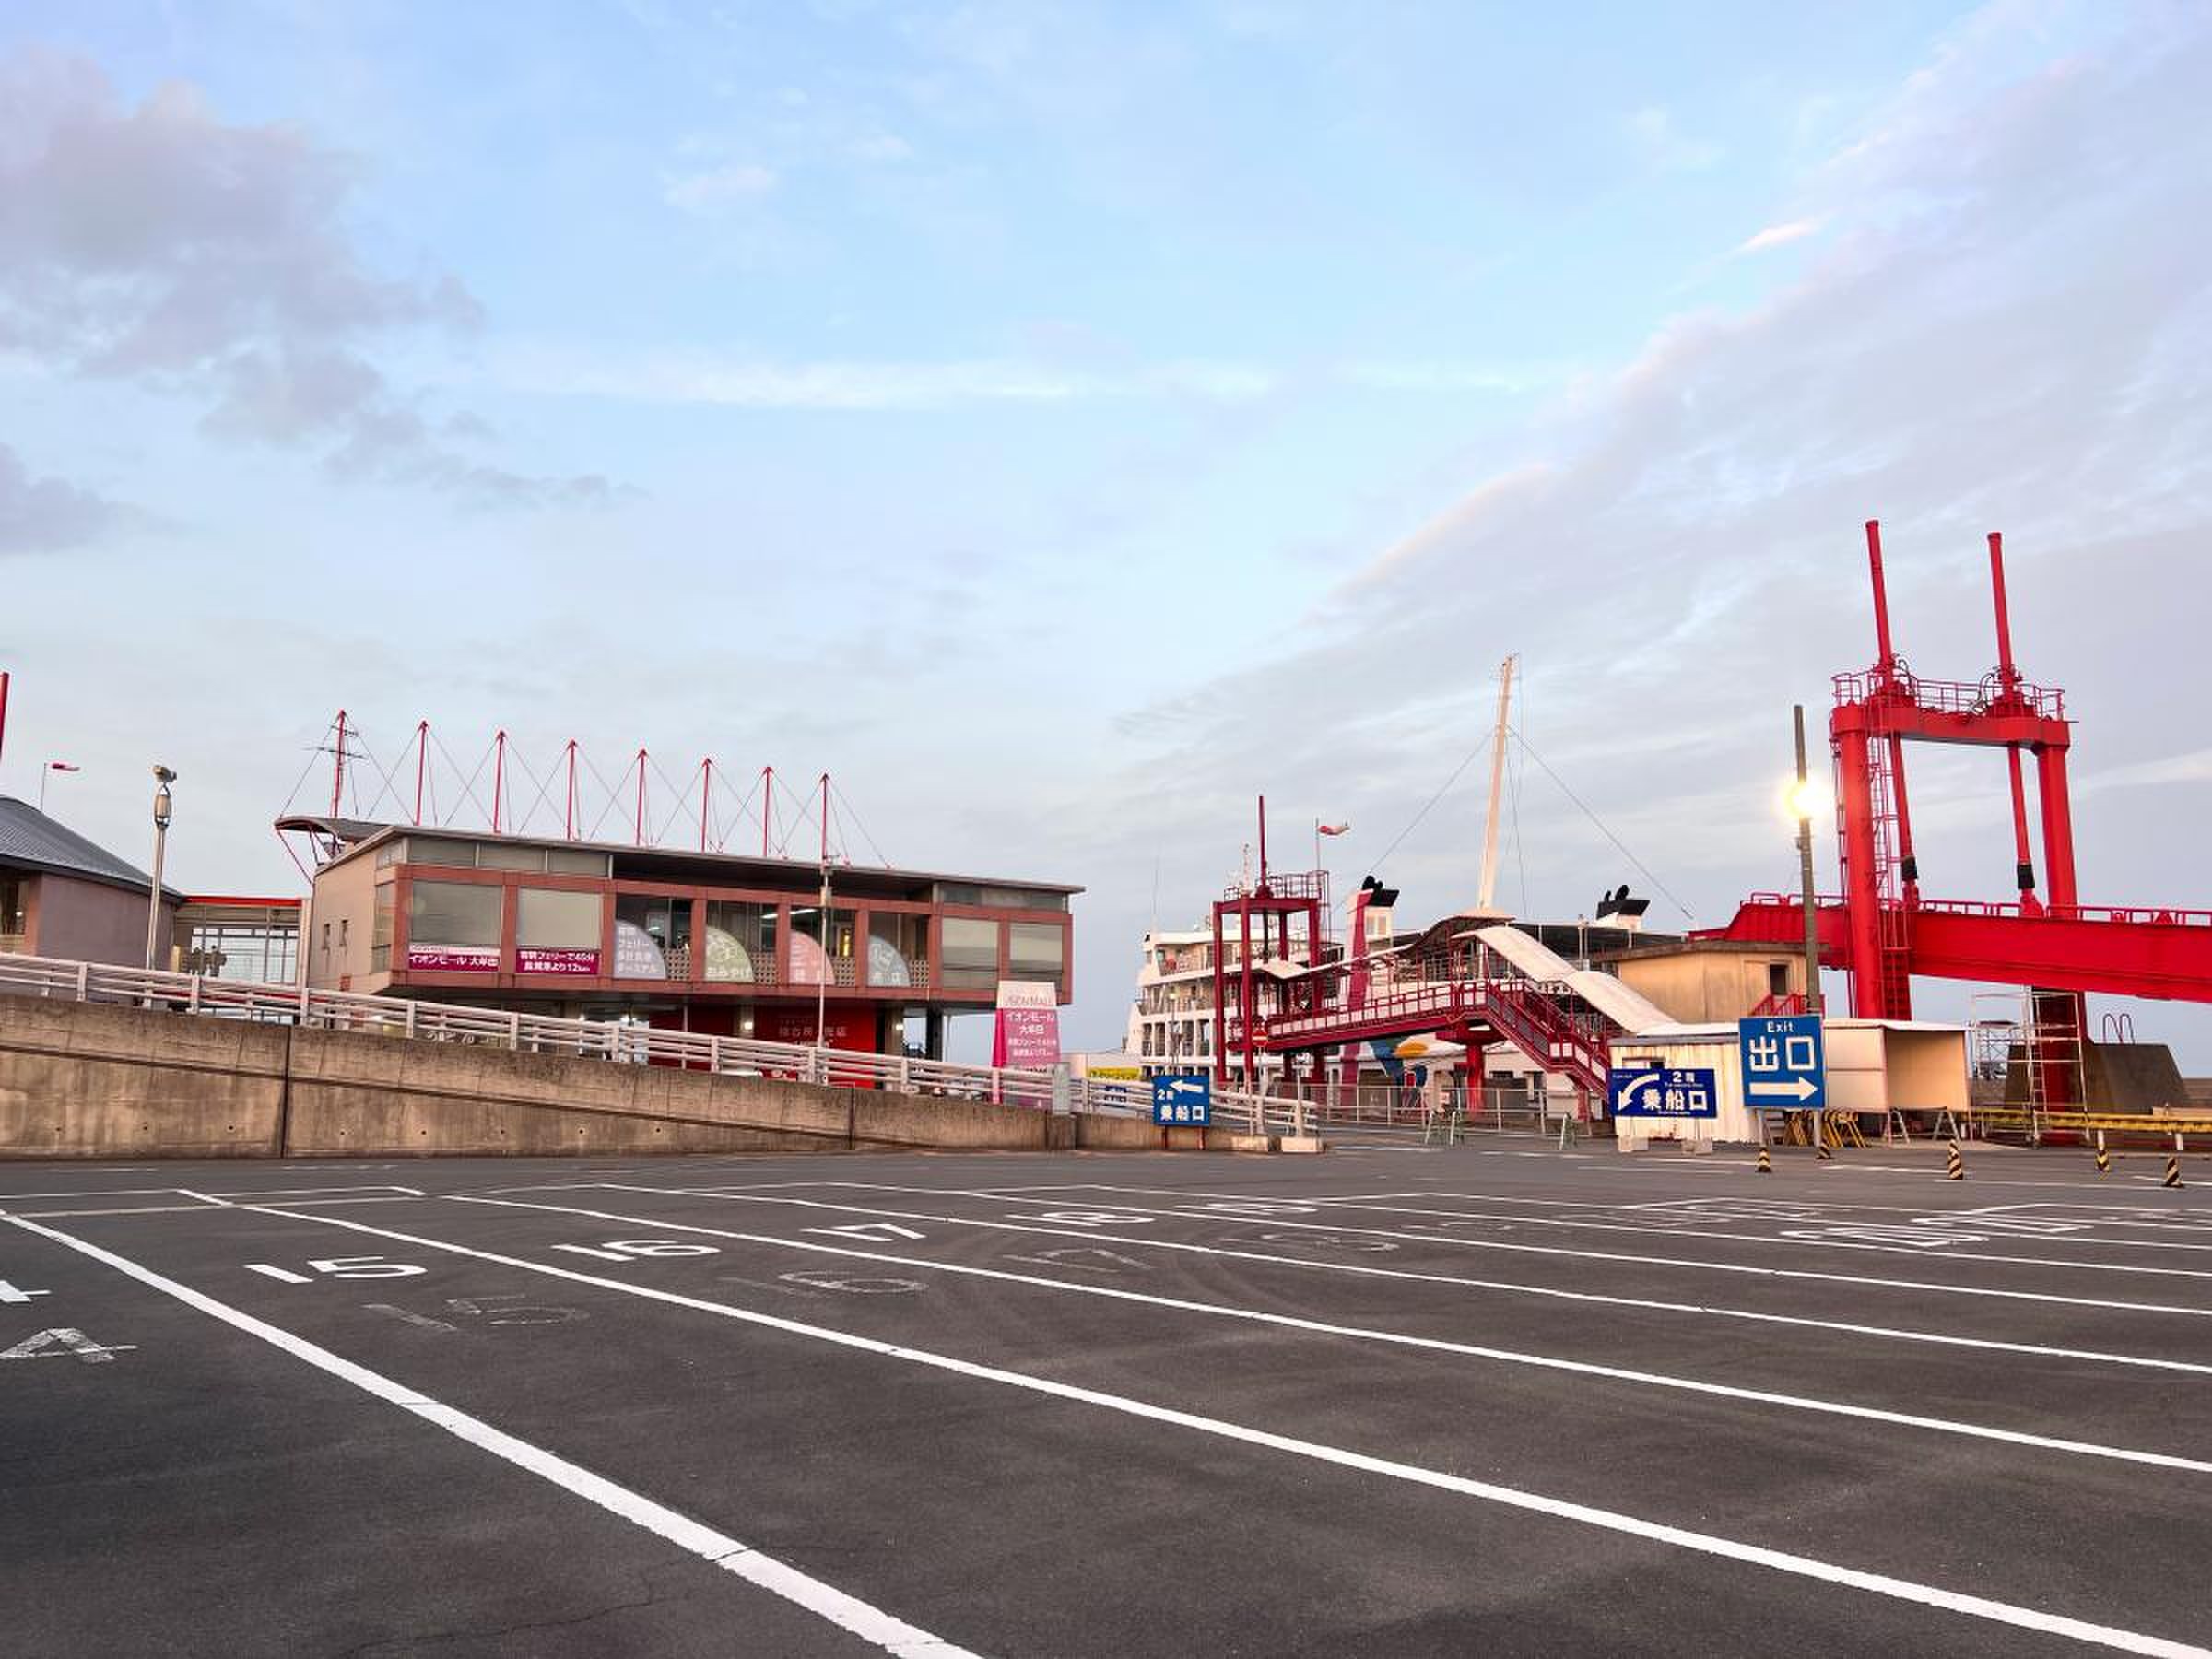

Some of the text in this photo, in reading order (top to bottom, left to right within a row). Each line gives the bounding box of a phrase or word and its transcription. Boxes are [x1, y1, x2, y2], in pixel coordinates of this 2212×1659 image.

[1767, 1020, 1794, 1033] Exit
[1749, 1035, 1816, 1072] 出口
[1641, 1088, 1708, 1111] 乗船口
[1159, 1105, 1205, 1122] 乗船口
[1005, 1211, 1155, 1227] 18
[799, 1223, 927, 1241] 17
[551, 1239, 722, 1262] 16
[243, 1256, 428, 1284] 15
